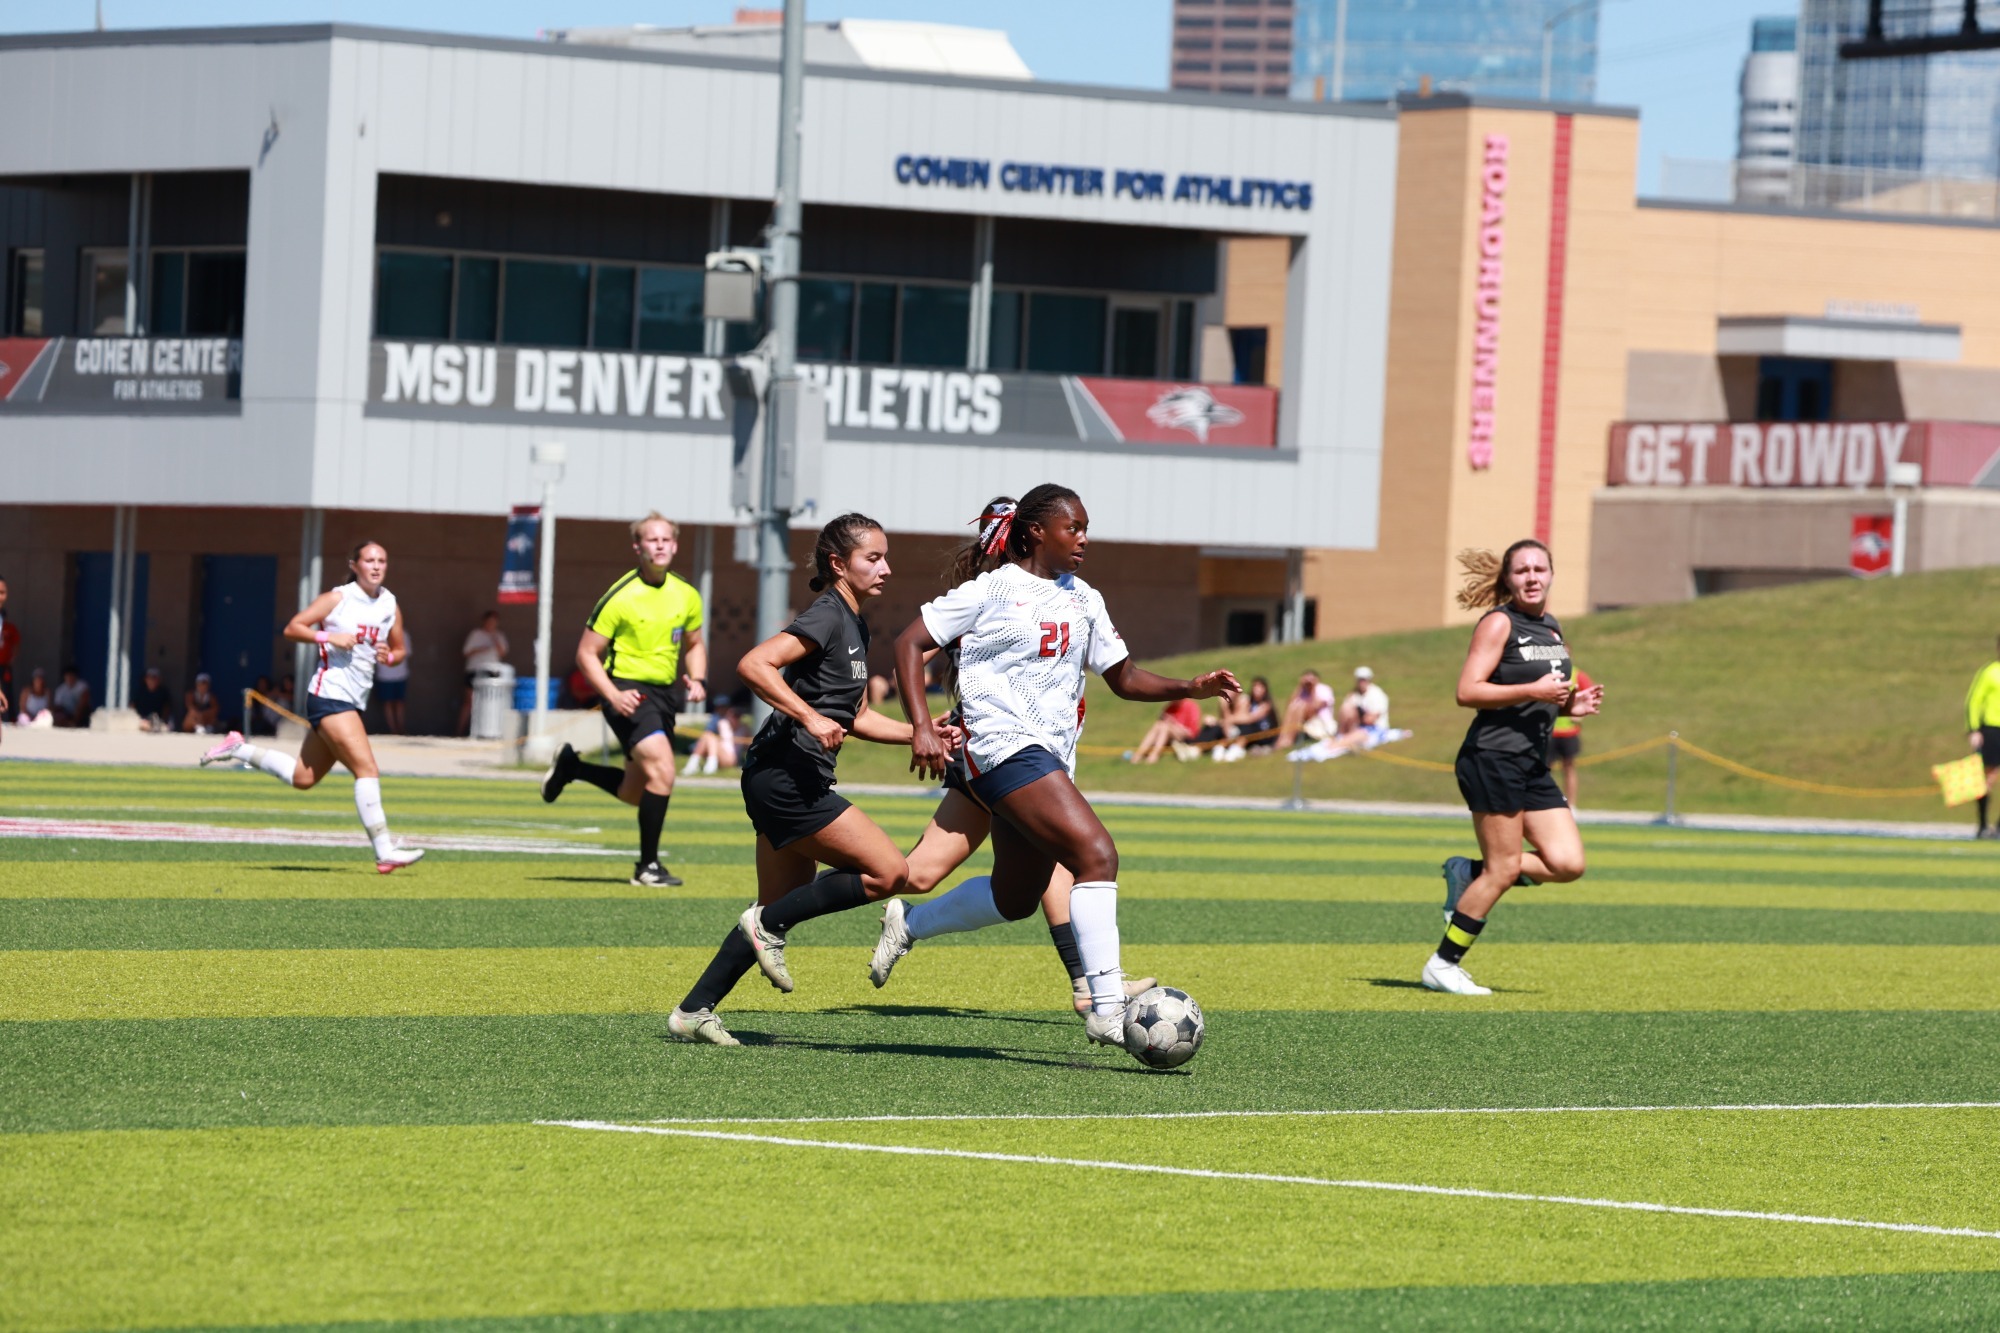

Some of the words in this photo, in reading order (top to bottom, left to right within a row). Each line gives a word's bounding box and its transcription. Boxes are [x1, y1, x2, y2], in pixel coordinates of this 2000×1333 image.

[895, 155, 990, 189] COHEN
[1000, 162, 1104, 196] CENTER
[1114, 168, 1165, 200] FOR
[1173, 173, 1313, 211] ATHLETICS
[75, 338, 149, 375] COHEN
[113, 379, 138, 399] FOR
[382, 342, 498, 406] MSU
[514, 348, 726, 420] DENVER
[795, 363, 1002, 435] HLETICS
[1625, 423, 1717, 484] GET
[1731, 423, 1910, 486] ROWDY
[356, 624, 379, 646] 24
[1039, 621, 1070, 658] 21
